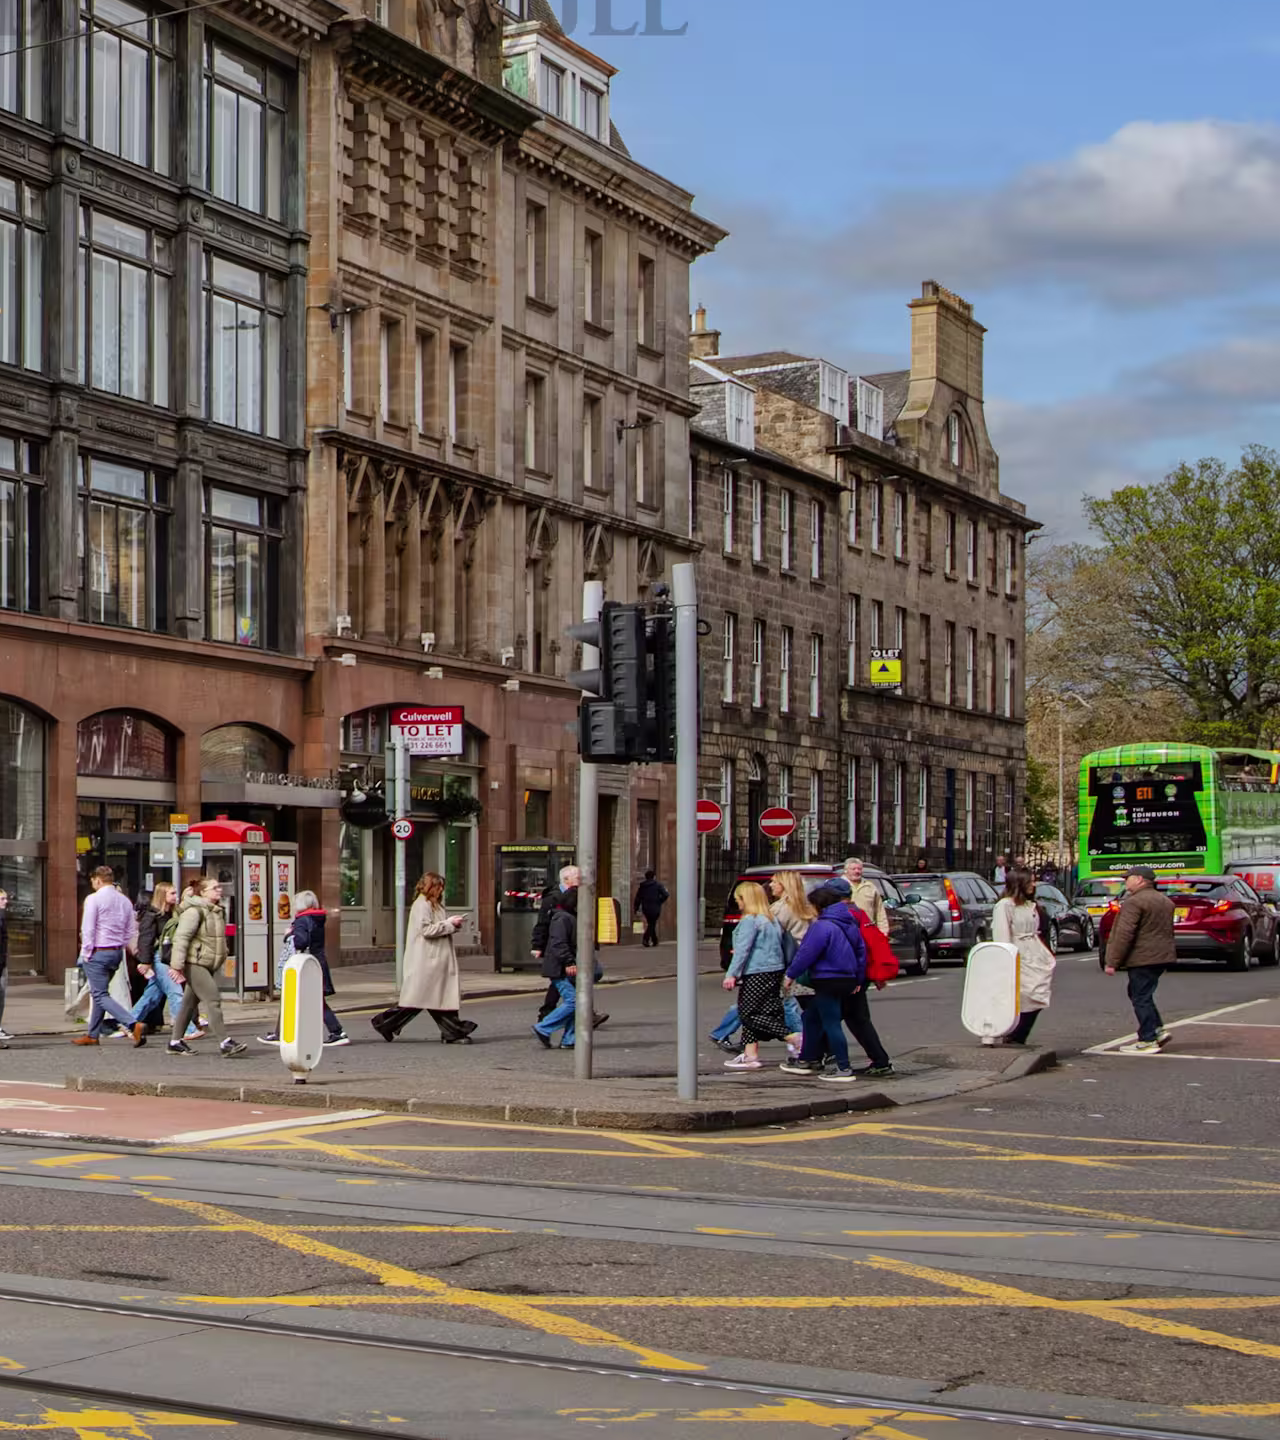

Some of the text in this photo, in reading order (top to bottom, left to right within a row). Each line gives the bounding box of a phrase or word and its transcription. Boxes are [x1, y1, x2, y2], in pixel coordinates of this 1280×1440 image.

[400, 712, 452, 721] Culverwell
[398, 725, 454, 736] TO LET
[246, 771, 339, 790] CHARLOTTE HOUSE
[396, 825, 410, 833] 20
